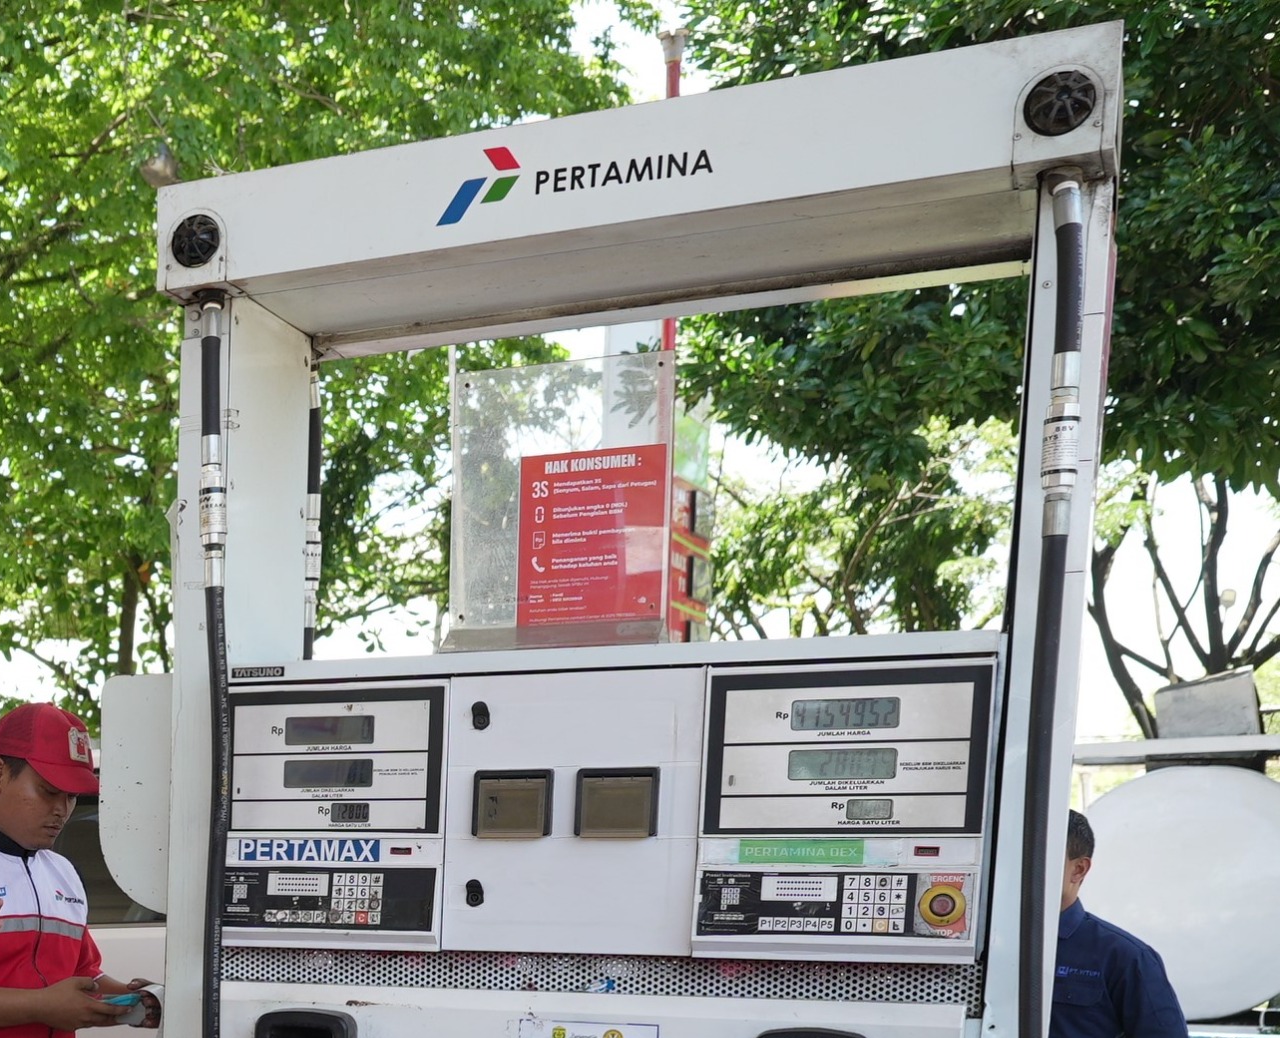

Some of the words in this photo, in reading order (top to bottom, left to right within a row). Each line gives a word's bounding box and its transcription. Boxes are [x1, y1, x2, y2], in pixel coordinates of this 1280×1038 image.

[535, 149, 713, 195] PERTAMINA
[545, 460, 568, 474] HAK
[570, 454, 636, 472] KONSUMEN
[532, 480, 549, 498] 3S
[234, 667, 283, 677] TATSUNO
[775, 712, 789, 720] Rp
[271, 726, 283, 736] Rp
[318, 806, 330, 815] Rp
[831, 802, 845, 810] Rp
[240, 839, 375, 862] PERTAMAX
[745, 847, 825, 857] PERTAMINA
[830, 847, 857, 857] DEX
[336, 875, 343, 884] 7
[348, 875, 355, 884] 8
[360, 875, 367, 884] 9
[848, 877, 855, 886] 7
[864, 877, 871, 886] 8
[932, 875, 965, 883] ERGENC
[360, 887, 367, 896] 6
[847, 892, 854, 900] 4
[863, 892, 870, 901] 5
[879, 892, 886, 901] 6
[847, 907, 852, 915] 1
[862, 907, 869, 916] 2
[760, 920, 771, 928] P1
[775, 920, 787, 928] P2
[790, 920, 802, 929] P3
[805, 920, 817, 928] P4
[820, 920, 833, 929] P5
[845, 921, 852, 929] 0
